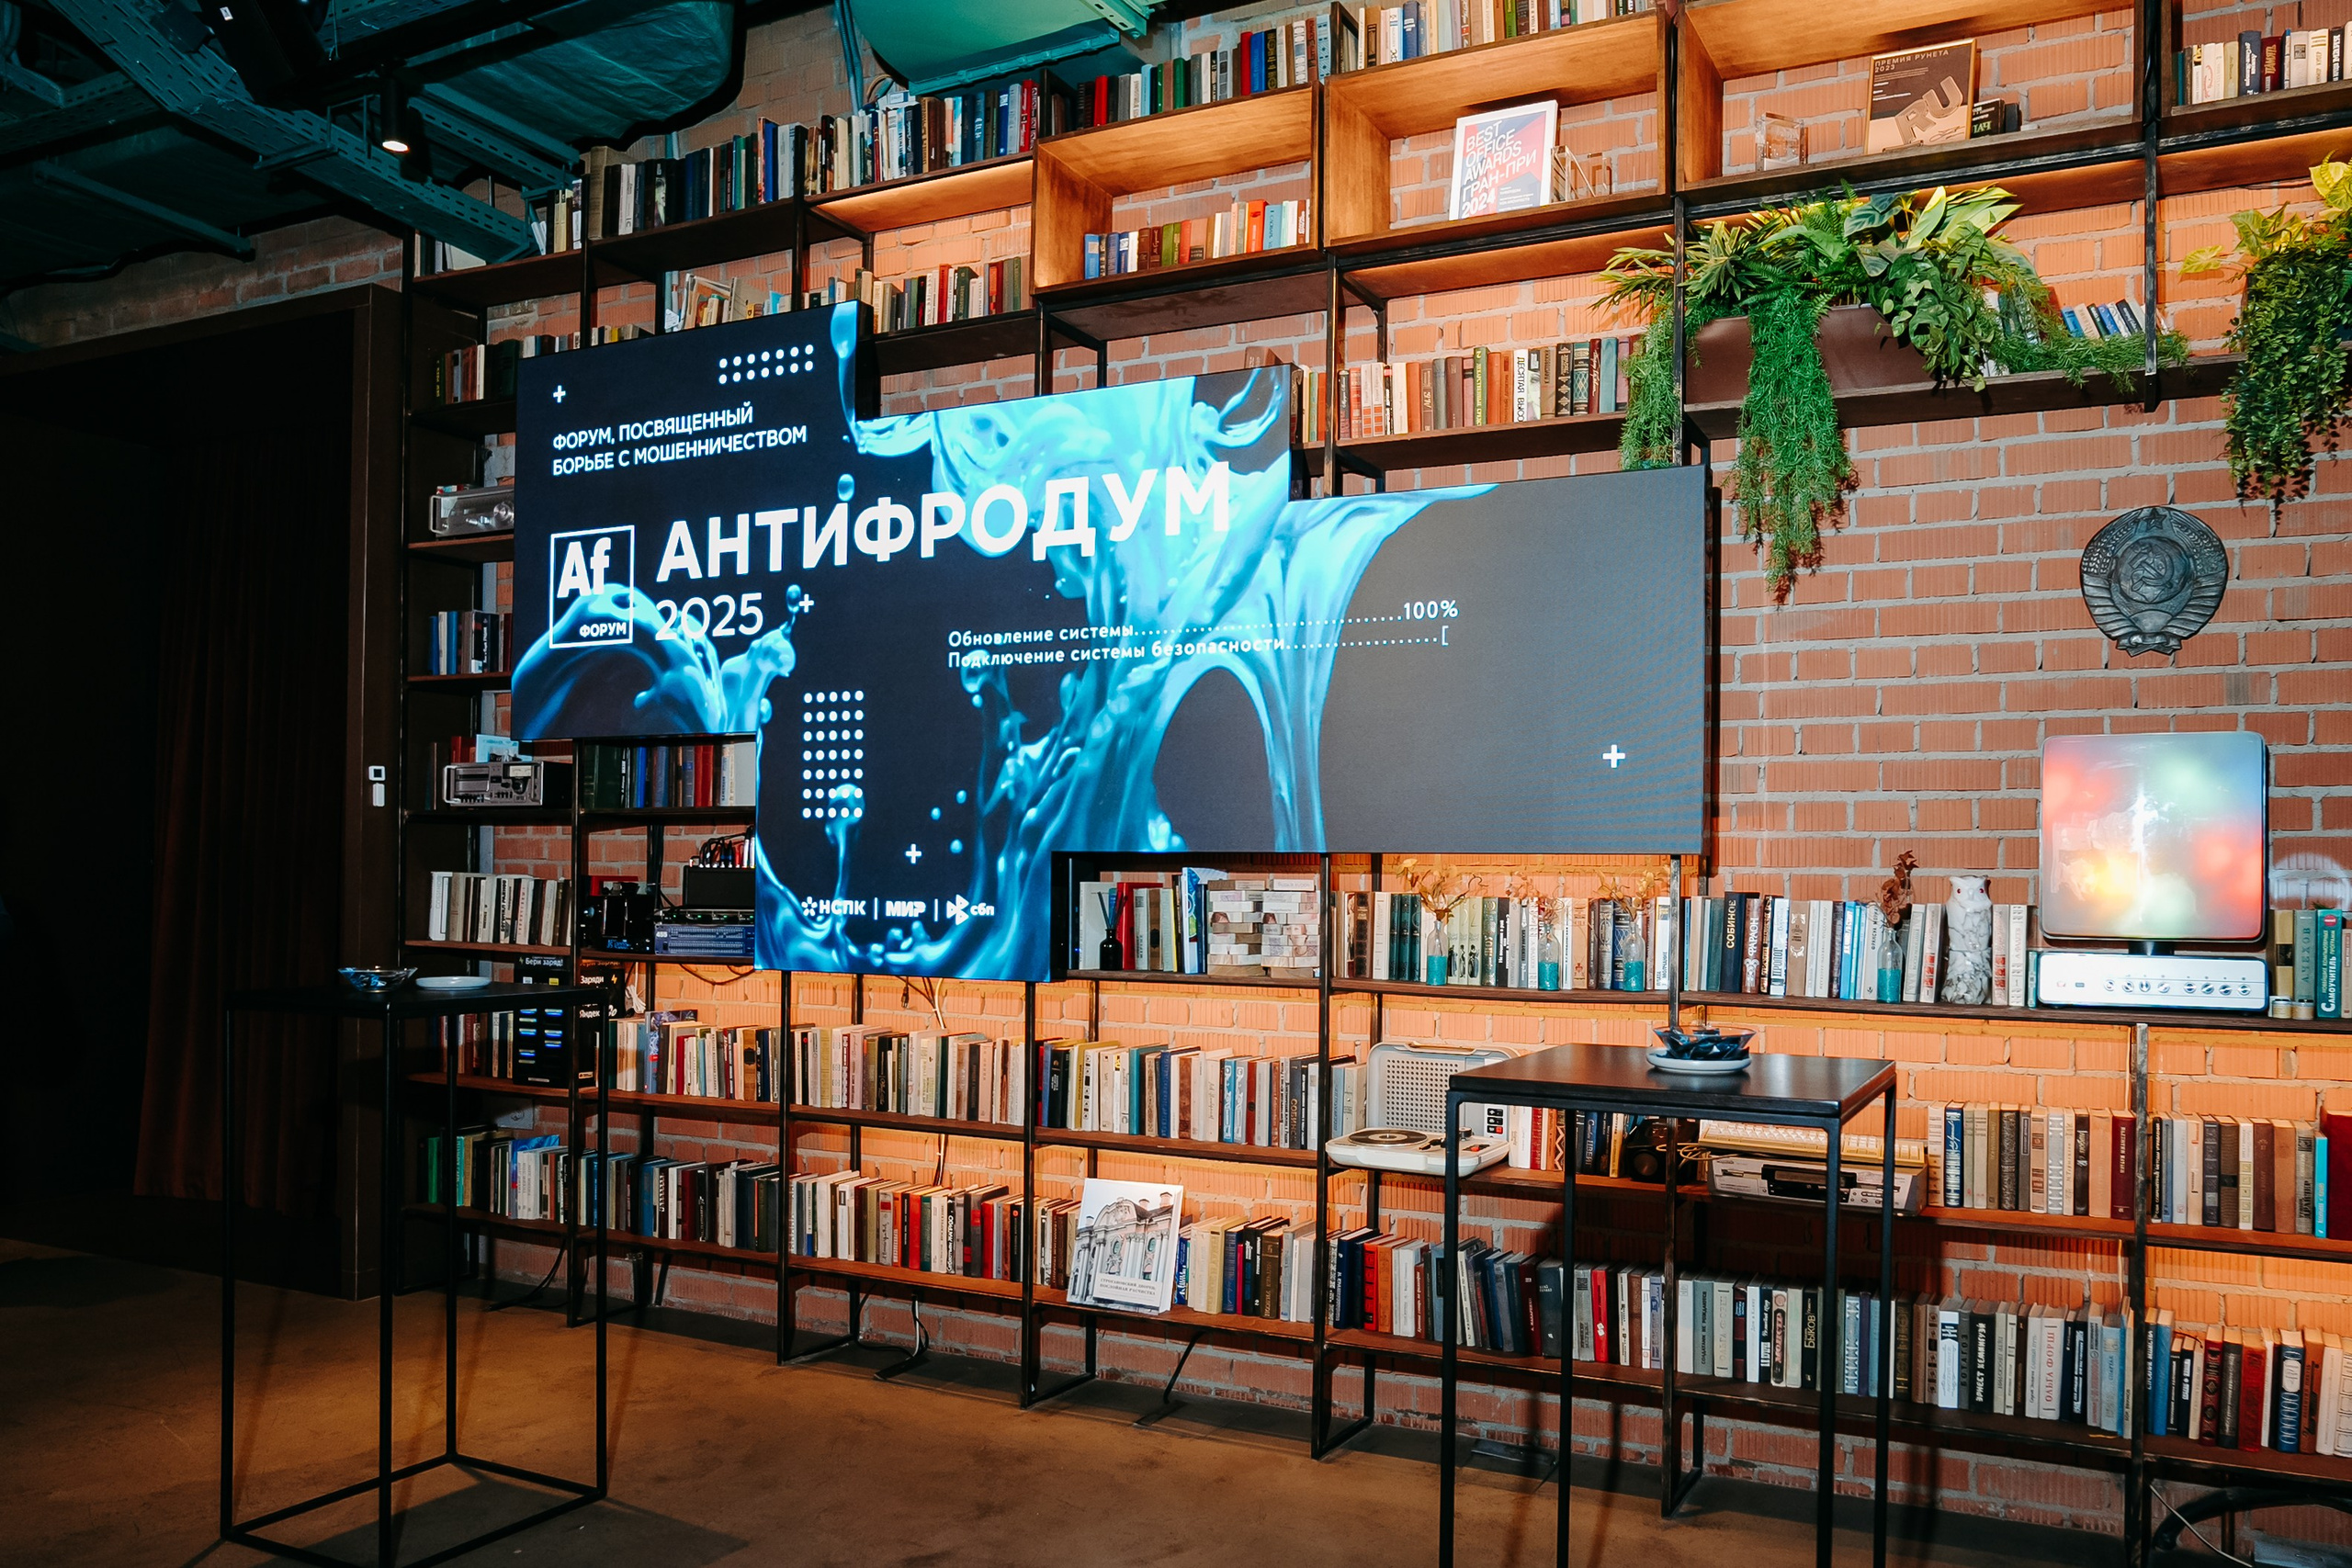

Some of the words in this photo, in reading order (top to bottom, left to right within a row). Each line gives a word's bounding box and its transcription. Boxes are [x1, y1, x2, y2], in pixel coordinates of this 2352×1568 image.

[1874, 55, 1912, 67] ПРЕМИЯ
[1915, 49, 1950, 61] РУНЕТА
[1874, 64, 1895, 73] 2023
[1465, 129, 1516, 168] OFFICE
[1466, 120, 1503, 153] BEST
[1463, 149, 1537, 202] ГРАН-ПРИ
[1464, 141, 1522, 186] AWARDS
[1462, 188, 1496, 220] 2024
[1517, 356, 1525, 393] ДЕСЯТАЯ
[553, 426, 615, 453] ФОРУМ,
[618, 401, 754, 442] ПОСВЯЩЕННЫЙ
[553, 450, 615, 476] БОРЬБЕ
[618, 449, 630, 468] С
[634, 425, 808, 464] МОШЕННИЧЕСТВОМ
[656, 461, 1231, 583] АНТИФРОДУМ
[557, 537, 611, 599] Af
[579, 622, 627, 638] ФОРУМ
[655, 592, 763, 642] 2025
[948, 626, 1055, 648] Обновление
[948, 648, 1066, 669] Подключение
[1070, 645, 1146, 662] системы
[819, 899, 866, 916] НСПК
[886, 900, 926, 918] МИР
[970, 903, 995, 917] сбп
[1747, 917, 1759, 956] ФАРАОН
[526, 957, 541, 965] Бери
[543, 959, 563, 967] заряд!
[1772, 947, 1783, 977] ПРОЛОГ
[580, 976, 605, 985] Заряди
[580, 1010, 600, 1019] Яндек
[1804, 1314, 1815, 1349] БЫКОВ
[1976, 1323, 1986, 1370] ХЕМИНГУЭЙ
[1960, 1334, 1969, 1387] БОТАГОЗ
[2045, 1332, 2055, 1368] ФОРШ
[1975, 1371, 1984, 1403] ЭРНЕСТ
[2045, 1371, 2053, 1403] ОЛЬГА
